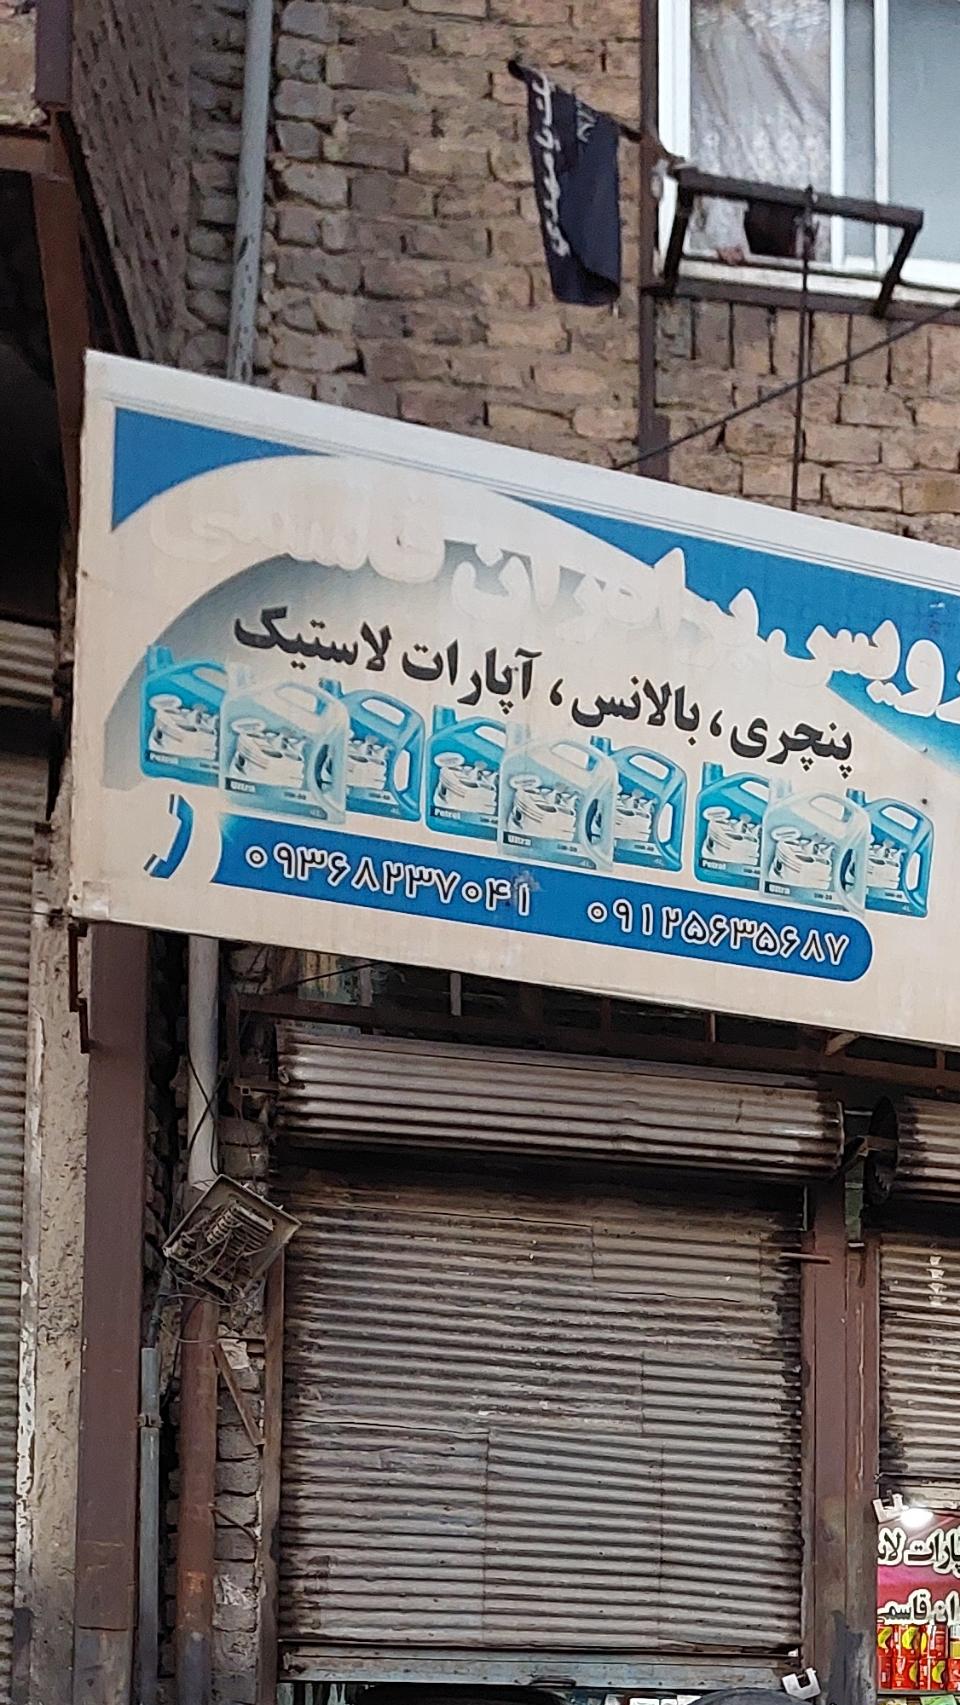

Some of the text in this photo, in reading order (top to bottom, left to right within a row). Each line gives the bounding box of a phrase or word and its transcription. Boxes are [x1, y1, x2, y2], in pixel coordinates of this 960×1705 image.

[234, 606, 392, 672] لاستیک
[402, 640, 542, 716] آپارات
[245, 842, 530, 916] ۰۹۳۶۸۲۳۷۰۴۱
[587, 898, 849, 965] ۰۹۱۲۵۶۳۵۶۸۷
